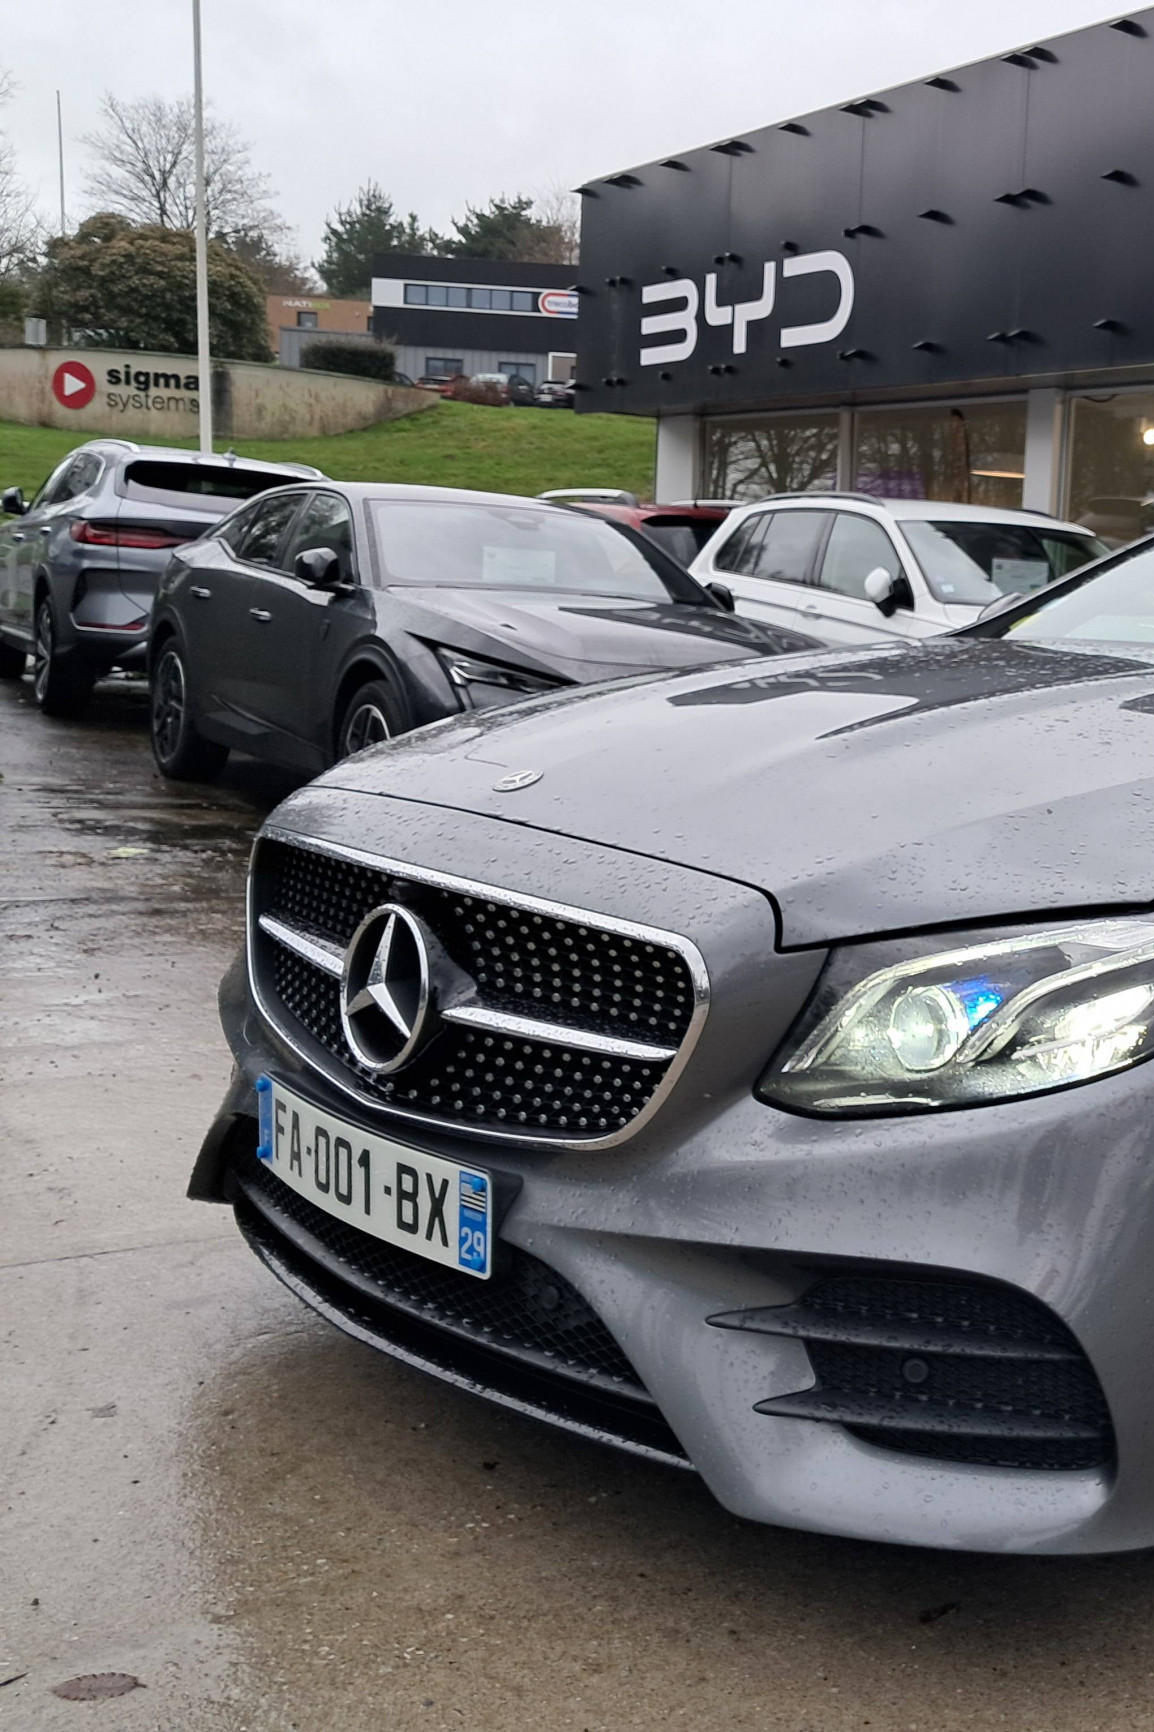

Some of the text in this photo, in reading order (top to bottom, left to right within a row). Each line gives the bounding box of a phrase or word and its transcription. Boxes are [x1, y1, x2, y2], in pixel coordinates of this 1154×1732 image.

[640, 250, 855, 366] BYD
[106, 364, 199, 391] sigma
[106, 392, 200, 414] systems
[274, 1098, 450, 1249] FA-001-BX
[460, 1226, 486, 1262] 29
